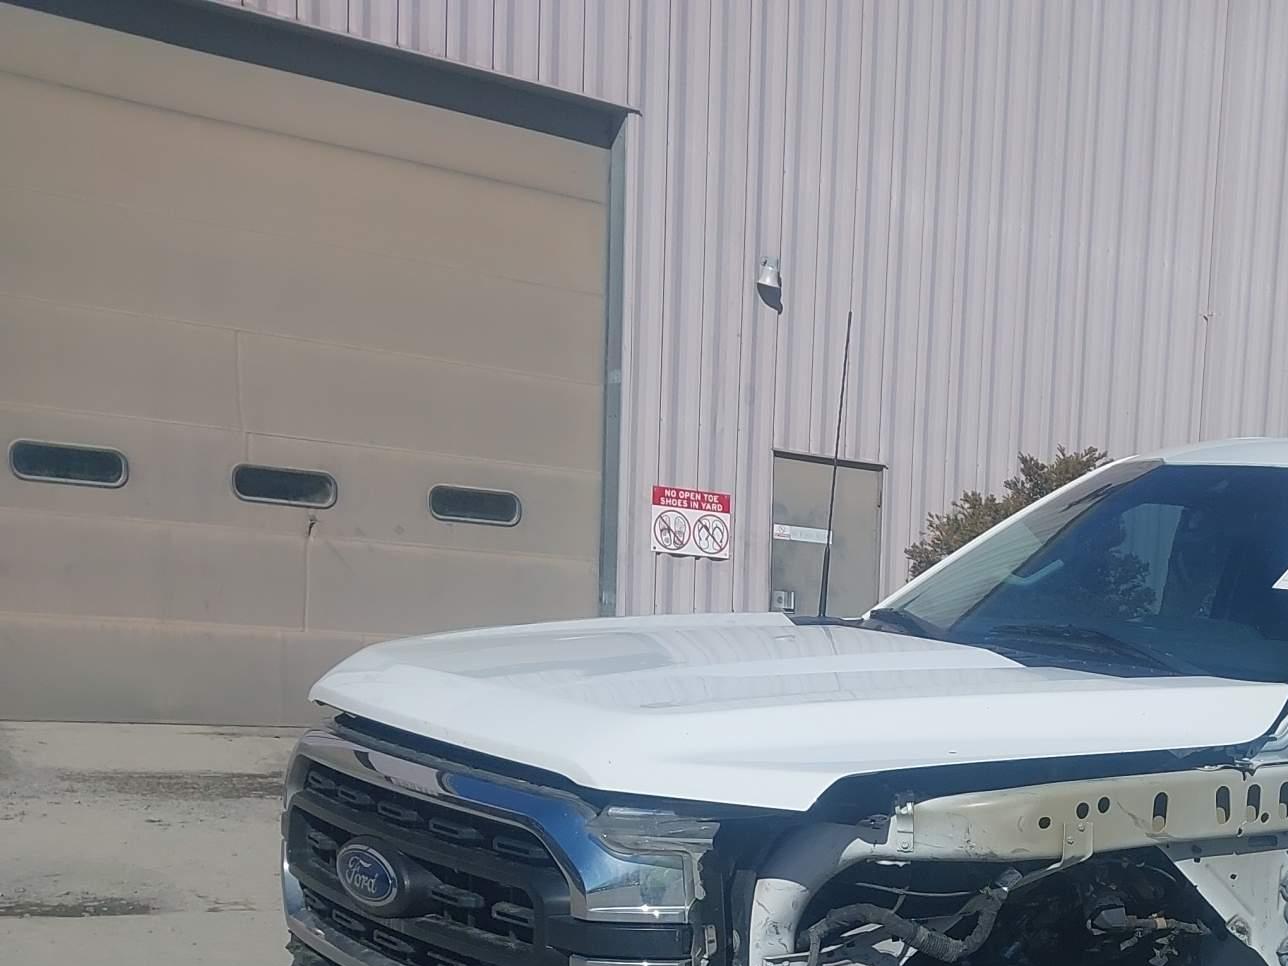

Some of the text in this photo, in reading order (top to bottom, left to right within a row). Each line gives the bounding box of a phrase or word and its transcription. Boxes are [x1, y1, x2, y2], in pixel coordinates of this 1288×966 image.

[664, 488, 720, 503] NO OPEN TOE
[660, 497, 723, 512] SHOES IN YARD
[345, 855, 379, 894] Ford
